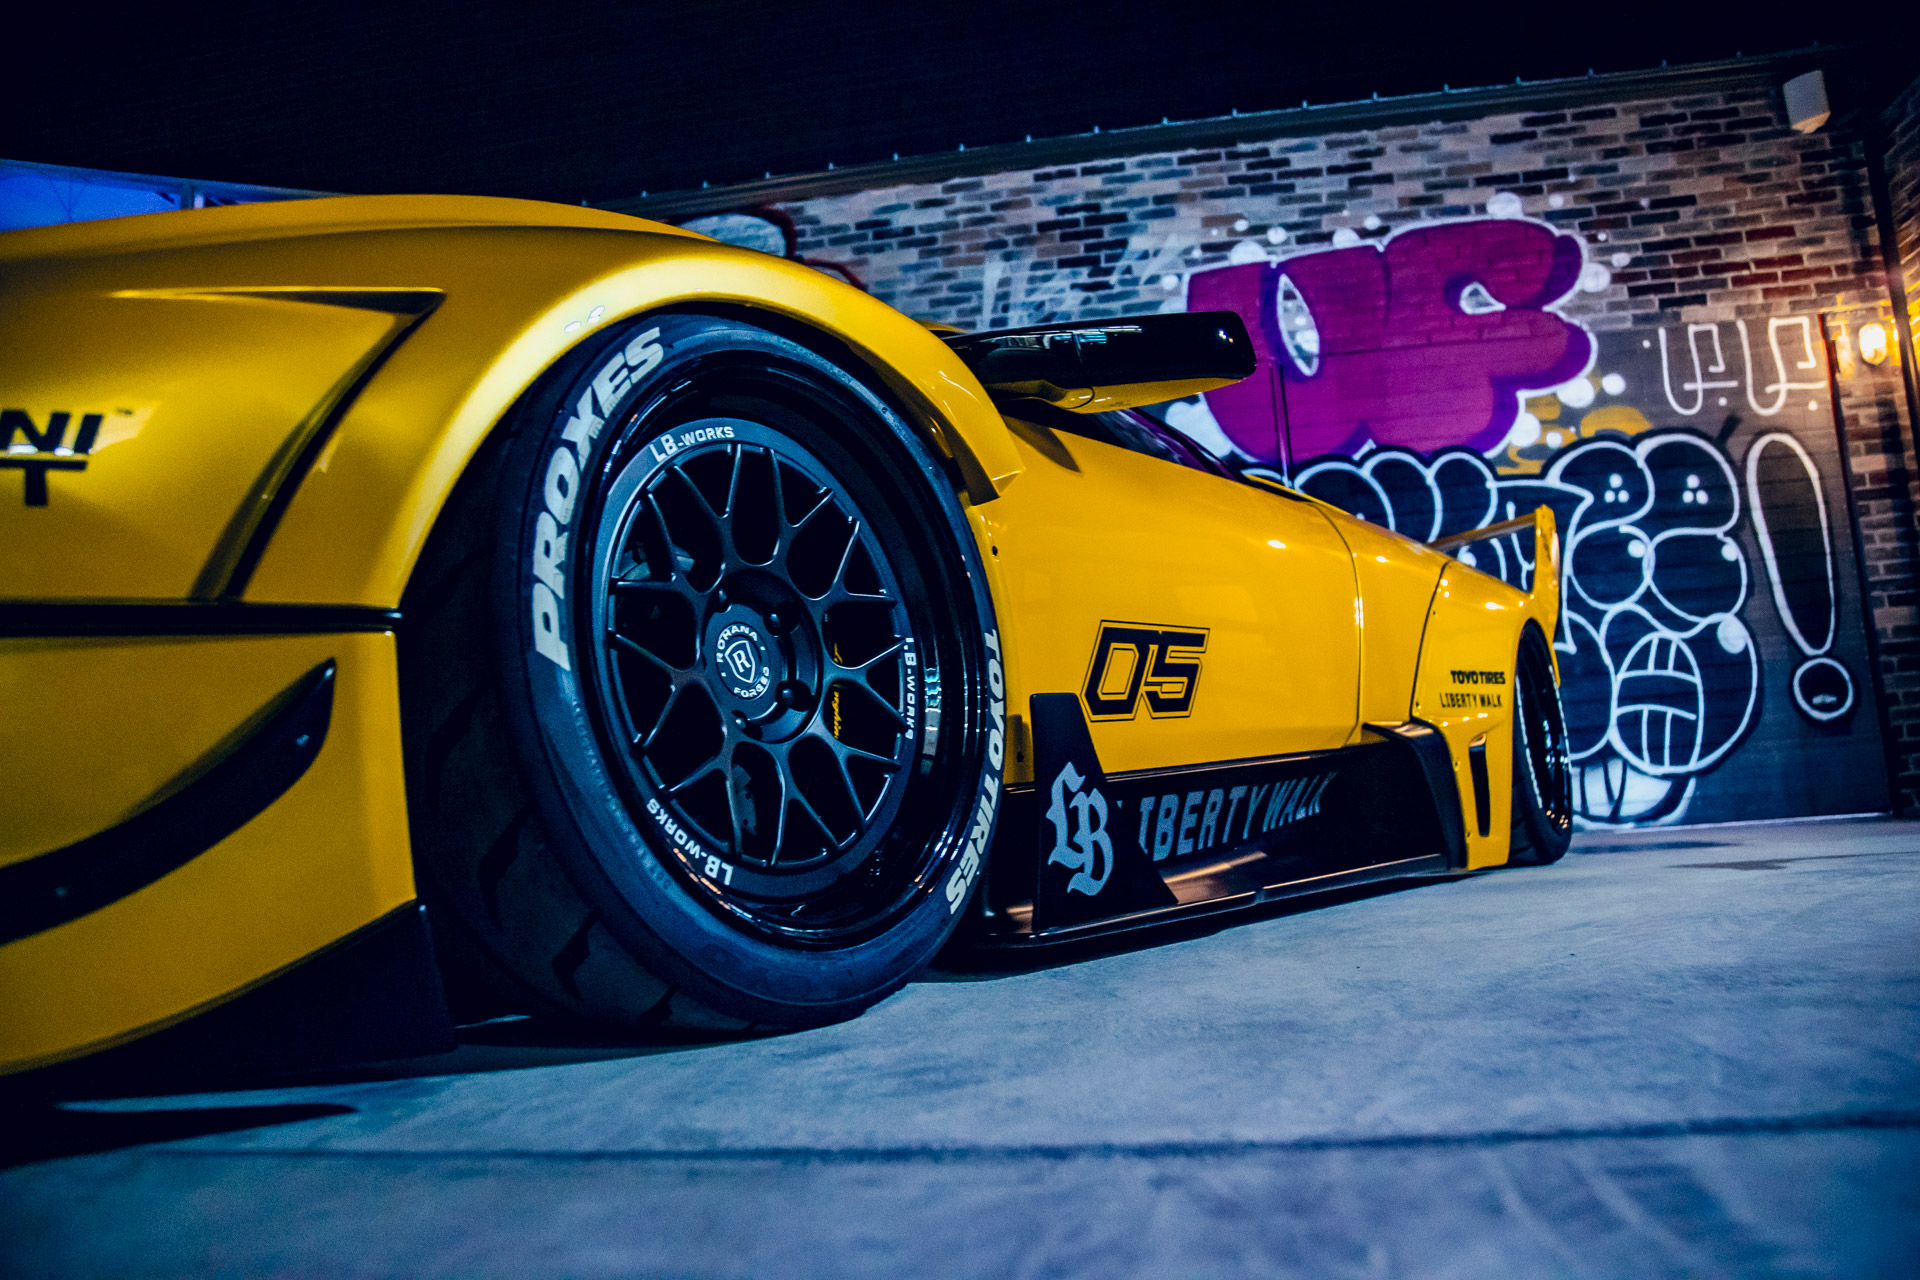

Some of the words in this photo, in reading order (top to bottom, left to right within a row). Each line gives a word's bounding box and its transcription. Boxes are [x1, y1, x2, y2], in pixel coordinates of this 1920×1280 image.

[649, 426, 735, 463] LB-WORKS
[532, 326, 665, 672] PROXES
[732, 649, 752, 673] R
[984, 629, 1004, 771] TOYO
[1080, 619, 1210, 723] 05
[1440, 692, 1477, 708] LIBERTY
[1479, 694, 1503, 708] WALK
[1450, 670, 1479, 684] TOYO
[1479, 671, 1506, 685] TIRES
[646, 798, 734, 886] LB-WORKS
[945, 773, 1000, 914] TIRES
[1117, 784, 1270, 862] IBERTY
[1262, 770, 1338, 833] WALK
